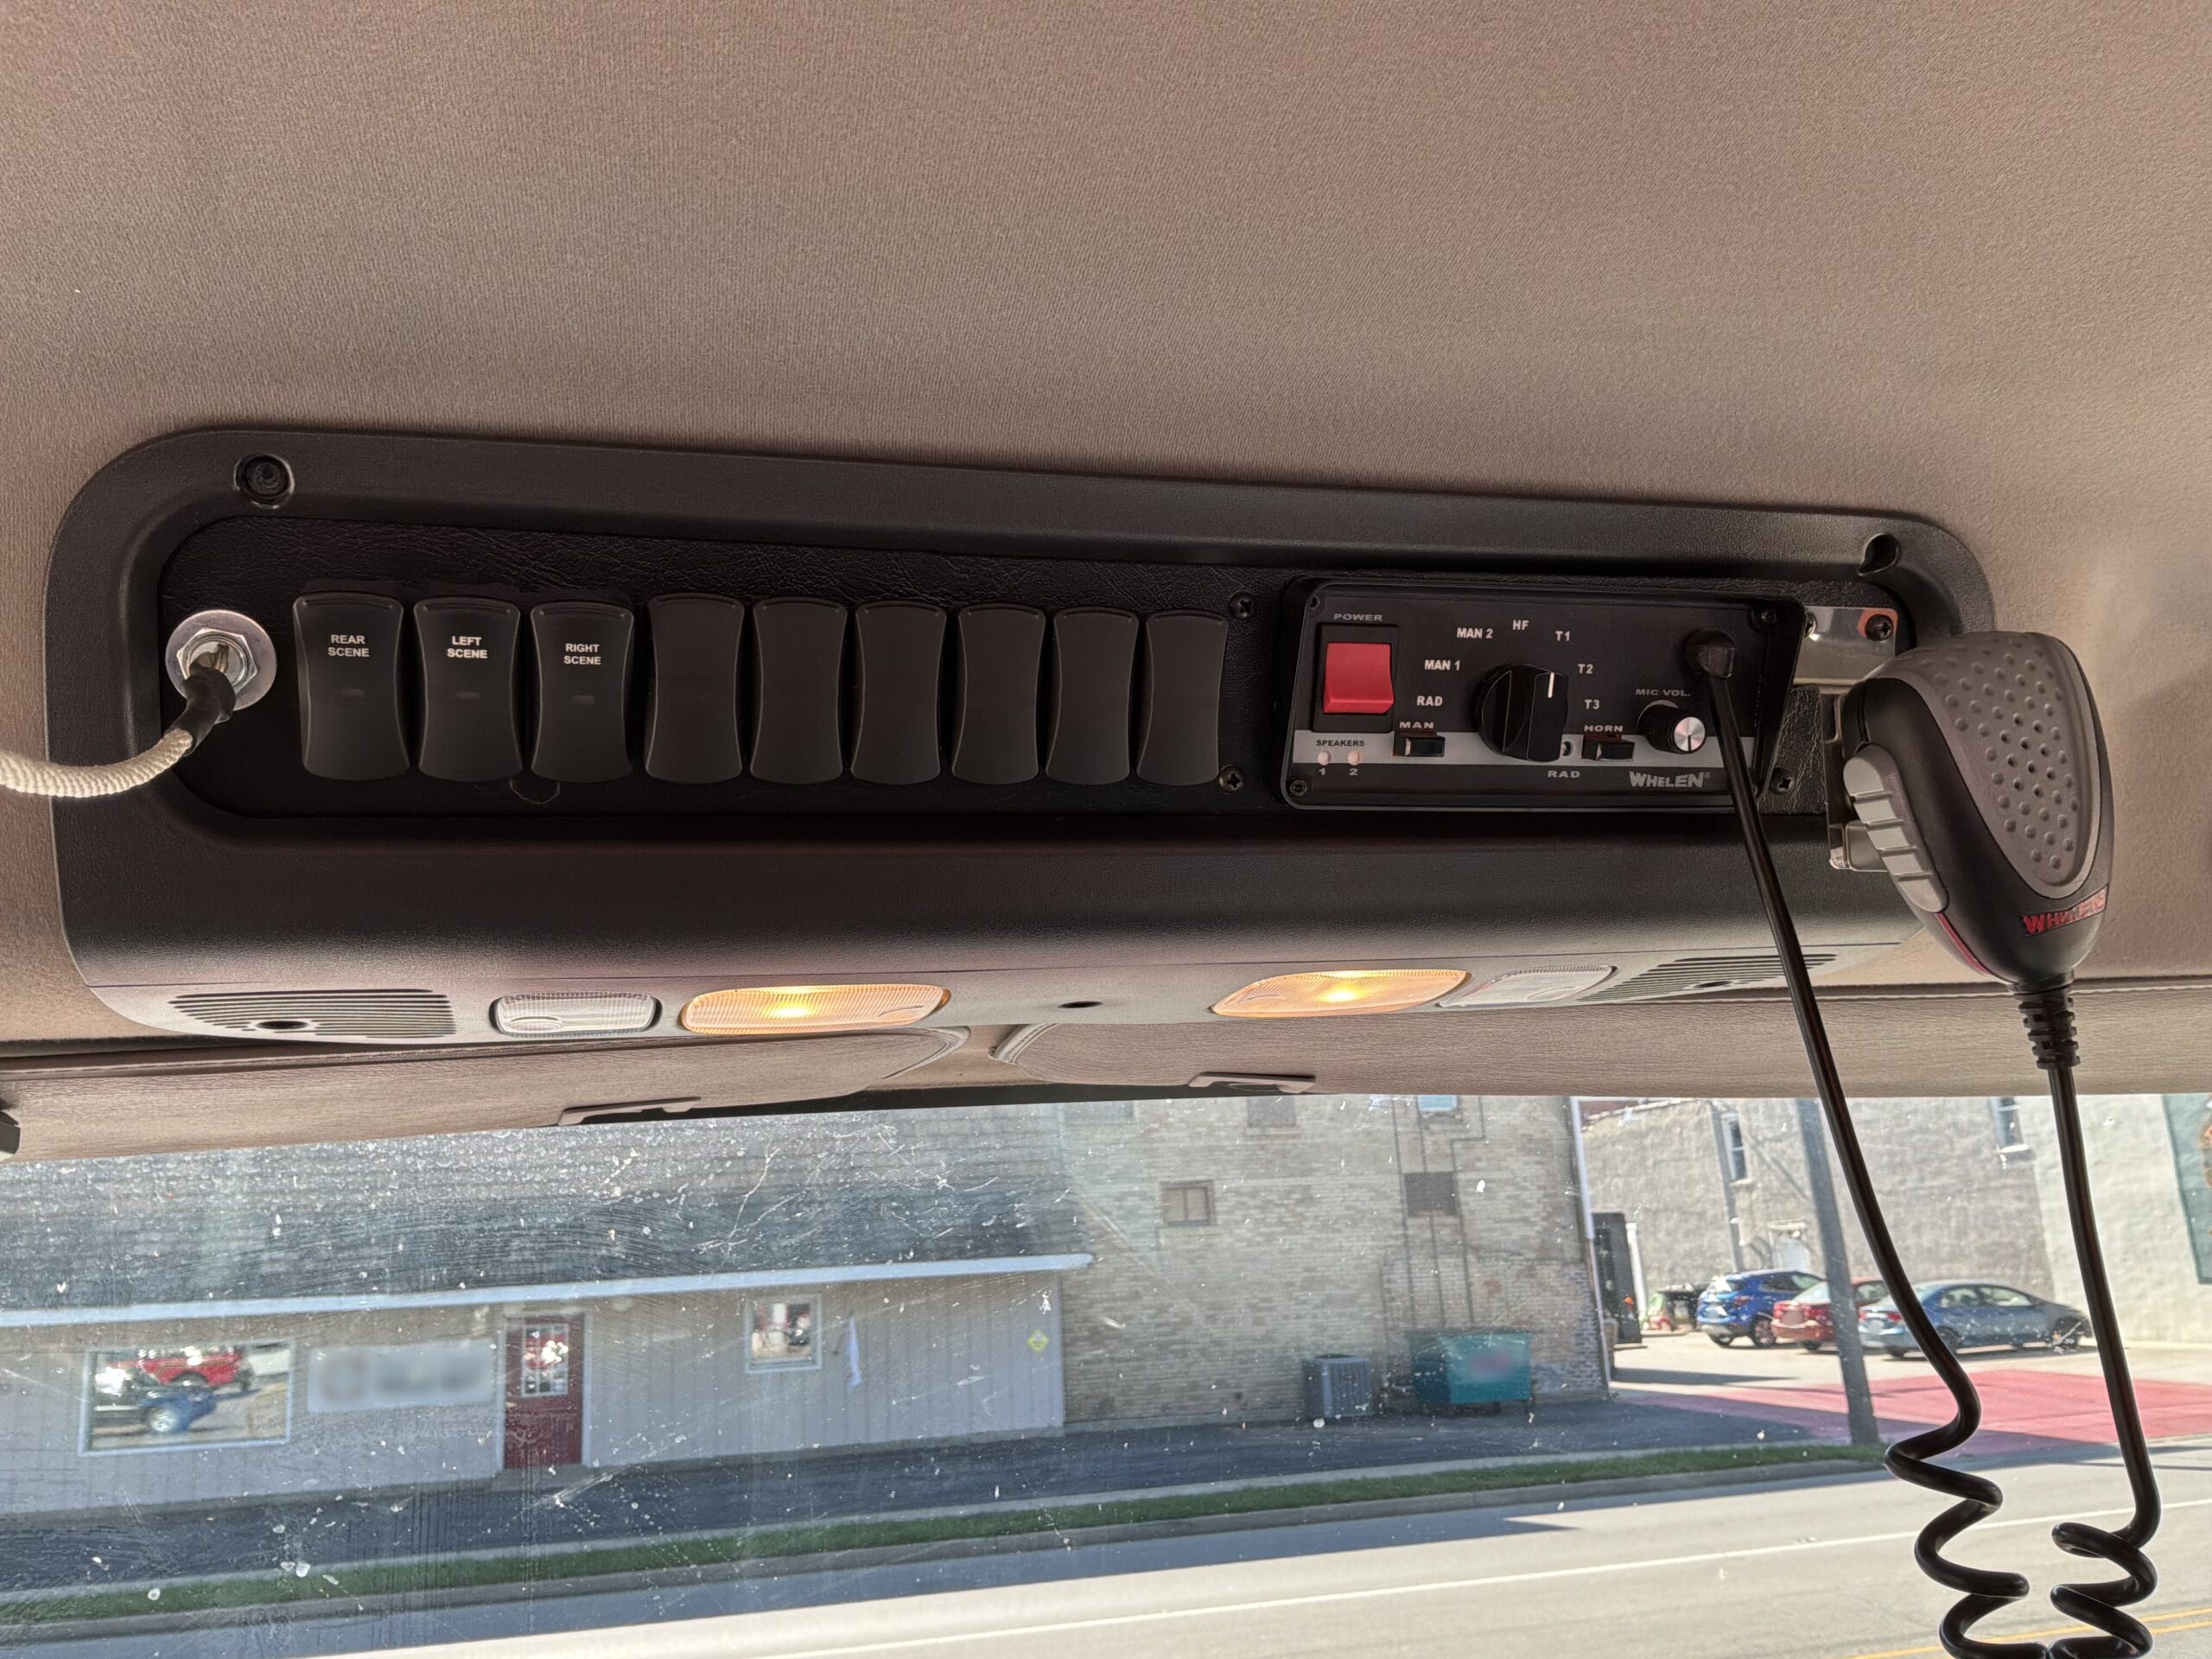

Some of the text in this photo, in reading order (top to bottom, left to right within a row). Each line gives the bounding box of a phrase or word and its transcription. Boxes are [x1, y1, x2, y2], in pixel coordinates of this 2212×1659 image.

[1333, 613, 1383, 621] POWER
[1512, 620, 1529, 631] HF
[1457, 627, 1493, 639] MAN 2
[1555, 631, 1571, 641] T1
[330, 634, 365, 645] REAR
[451, 635, 482, 646] LEFT
[327, 646, 370, 658] SCENE
[447, 648, 488, 659] SCENE
[564, 643, 600, 654] RIGHT
[563, 655, 601, 665] SCENE
[1424, 659, 1460, 671] MAN 1
[1577, 664, 1593, 674] T2
[1416, 696, 1443, 707] RAD
[1584, 699, 1600, 709] T3
[1584, 724, 1624, 733] HORN
[1548, 770, 1580, 779] RAD
